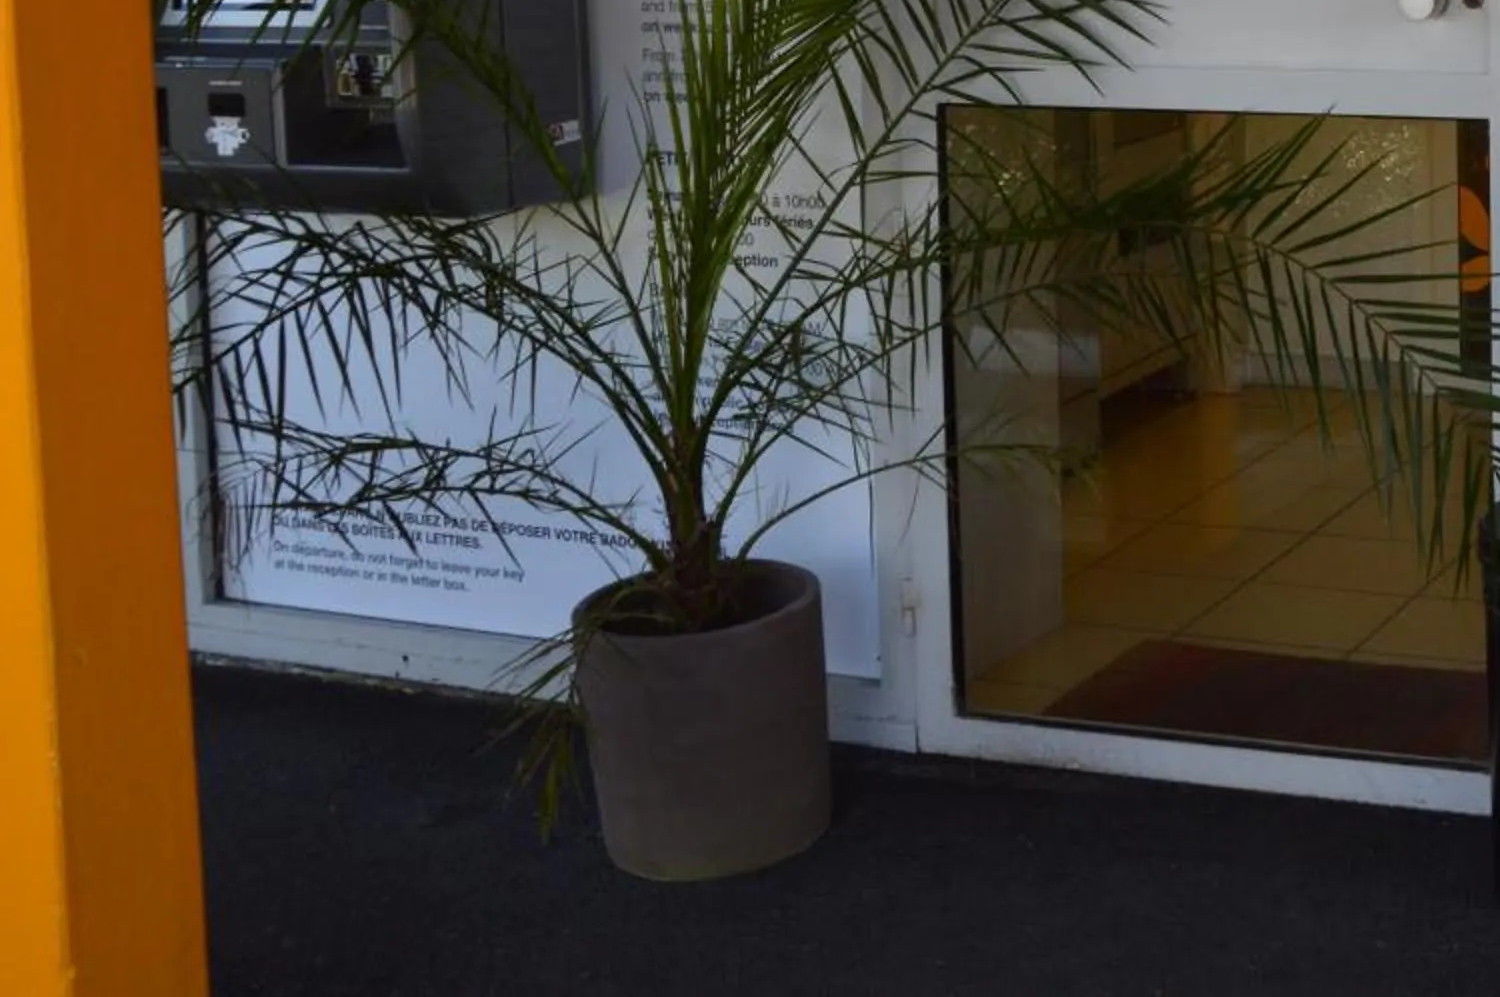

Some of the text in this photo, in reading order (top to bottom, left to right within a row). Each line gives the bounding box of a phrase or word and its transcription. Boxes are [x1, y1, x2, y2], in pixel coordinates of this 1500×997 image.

[444, 514, 468, 530] PAS
[471, 518, 489, 532] DE
[554, 527, 597, 544] VOTRE
[307, 564, 360, 579] reception
[362, 570, 374, 581] or
[390, 571, 408, 583] the
[475, 567, 500, 579] your
